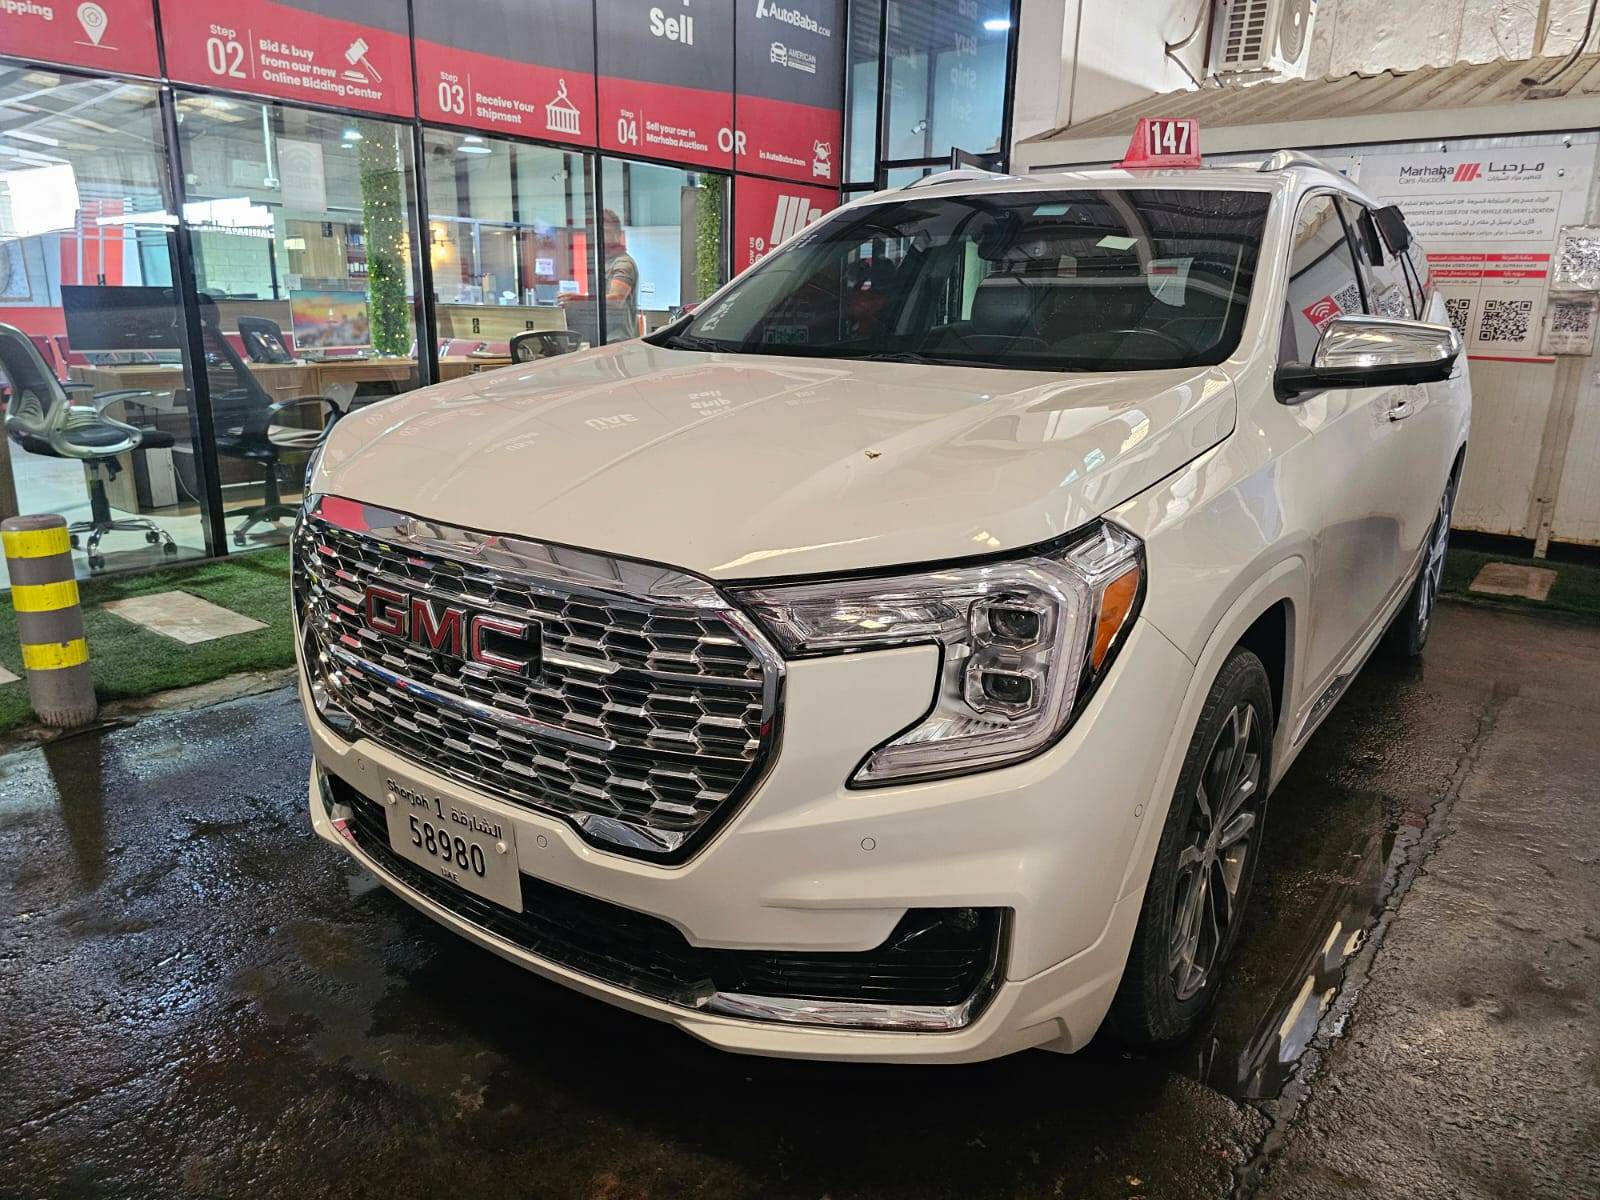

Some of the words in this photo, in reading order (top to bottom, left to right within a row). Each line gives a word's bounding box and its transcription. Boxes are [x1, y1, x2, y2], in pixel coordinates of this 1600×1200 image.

[210, 24, 236, 40] Step
[650, 7, 694, 46] Sell
[206, 38, 246, 79] 02
[260, 40, 278, 53] Bid
[281, 44, 290, 54] &
[292, 46, 314, 62] buy
[788, 48, 816, 64] AMERICAN
[260, 54, 290, 70] from
[293, 61, 310, 74] our
[313, 66, 336, 78] new
[440, 72, 458, 84] Step
[262, 70, 300, 86] Online
[302, 76, 345, 96] Bidding
[348, 84, 382, 100] Center
[438, 82, 464, 115] 03
[476, 92, 512, 109] Receive
[512, 100, 534, 113] Your
[476, 107, 522, 124] Shipment
[620, 108, 634, 119] Step
[618, 118, 638, 146] 04
[646, 122, 660, 131] Sell
[660, 124, 676, 134] your
[677, 128, 688, 136] car
[688, 128, 696, 138] in
[718, 128, 746, 156] OR
[1152, 121, 1190, 154] 147
[646, 133, 678, 146] Marhaba
[679, 139, 708, 152] Auctions
[1400, 165, 1454, 177] Marhaba
[364, 583, 535, 679] GMC
[387, 778, 430, 810] Sharjah
[434, 798, 446, 820] 1
[451, 808, 502, 840] الشارقة
[409, 813, 486, 877] 58980
[441, 866, 460, 882] UAE
